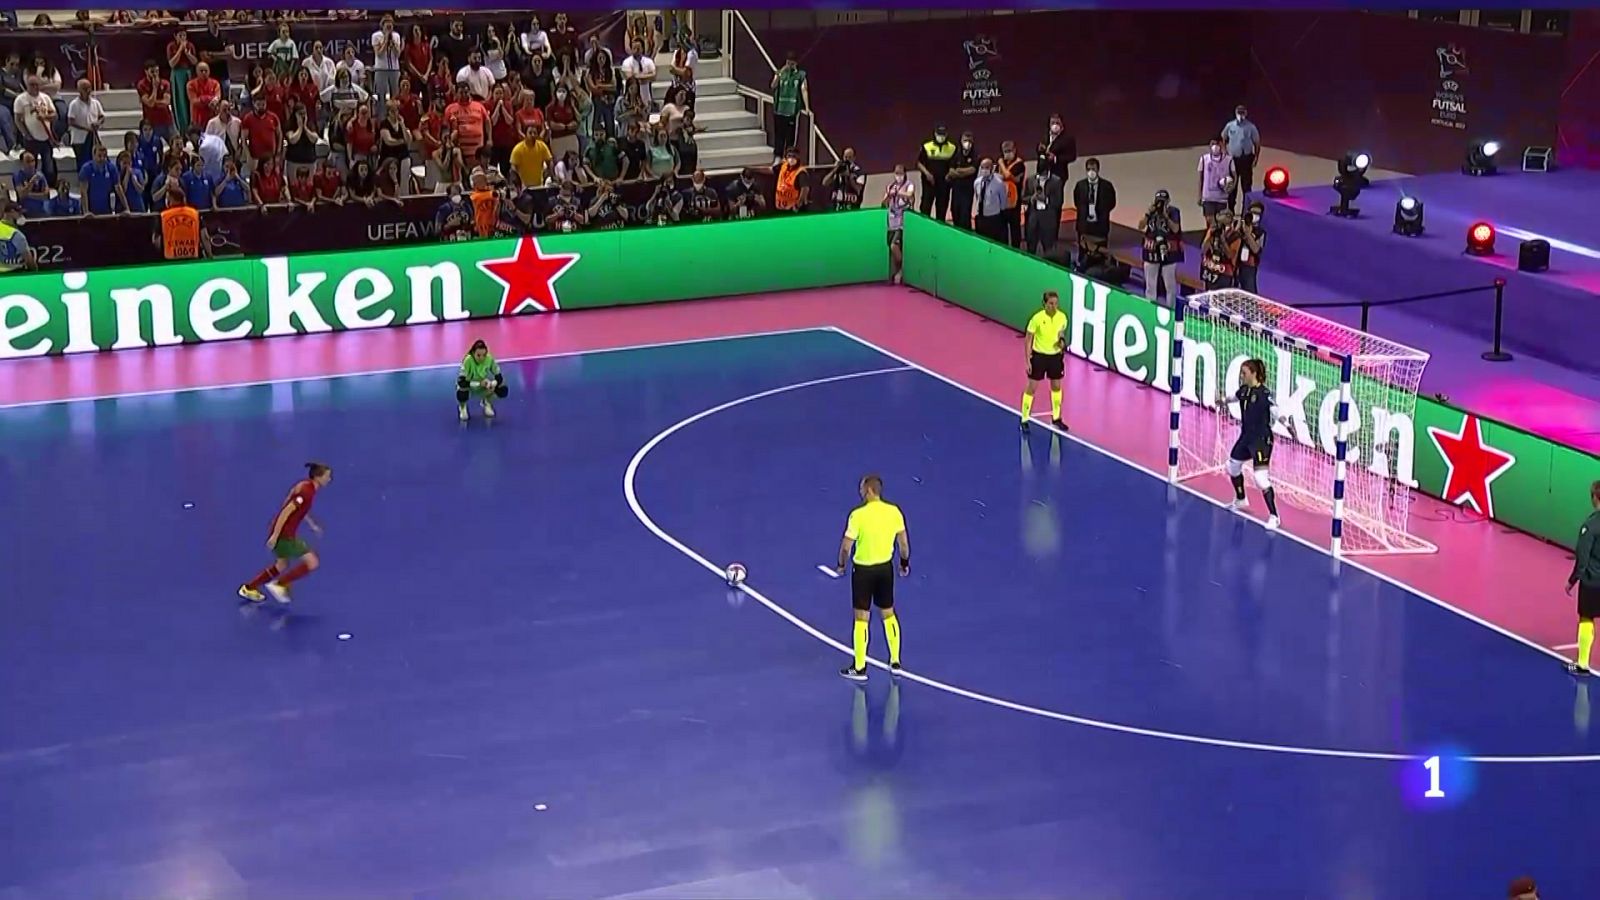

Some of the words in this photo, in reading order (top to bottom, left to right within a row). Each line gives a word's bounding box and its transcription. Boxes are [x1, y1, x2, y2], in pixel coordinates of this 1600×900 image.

[232, 42, 269, 60] UEF
[963, 88, 1002, 99] FUTSAL
[1432, 99, 1467, 113] FUTSAL
[367, 222, 419, 241] UEFA
[0, 256, 470, 360] eineken
